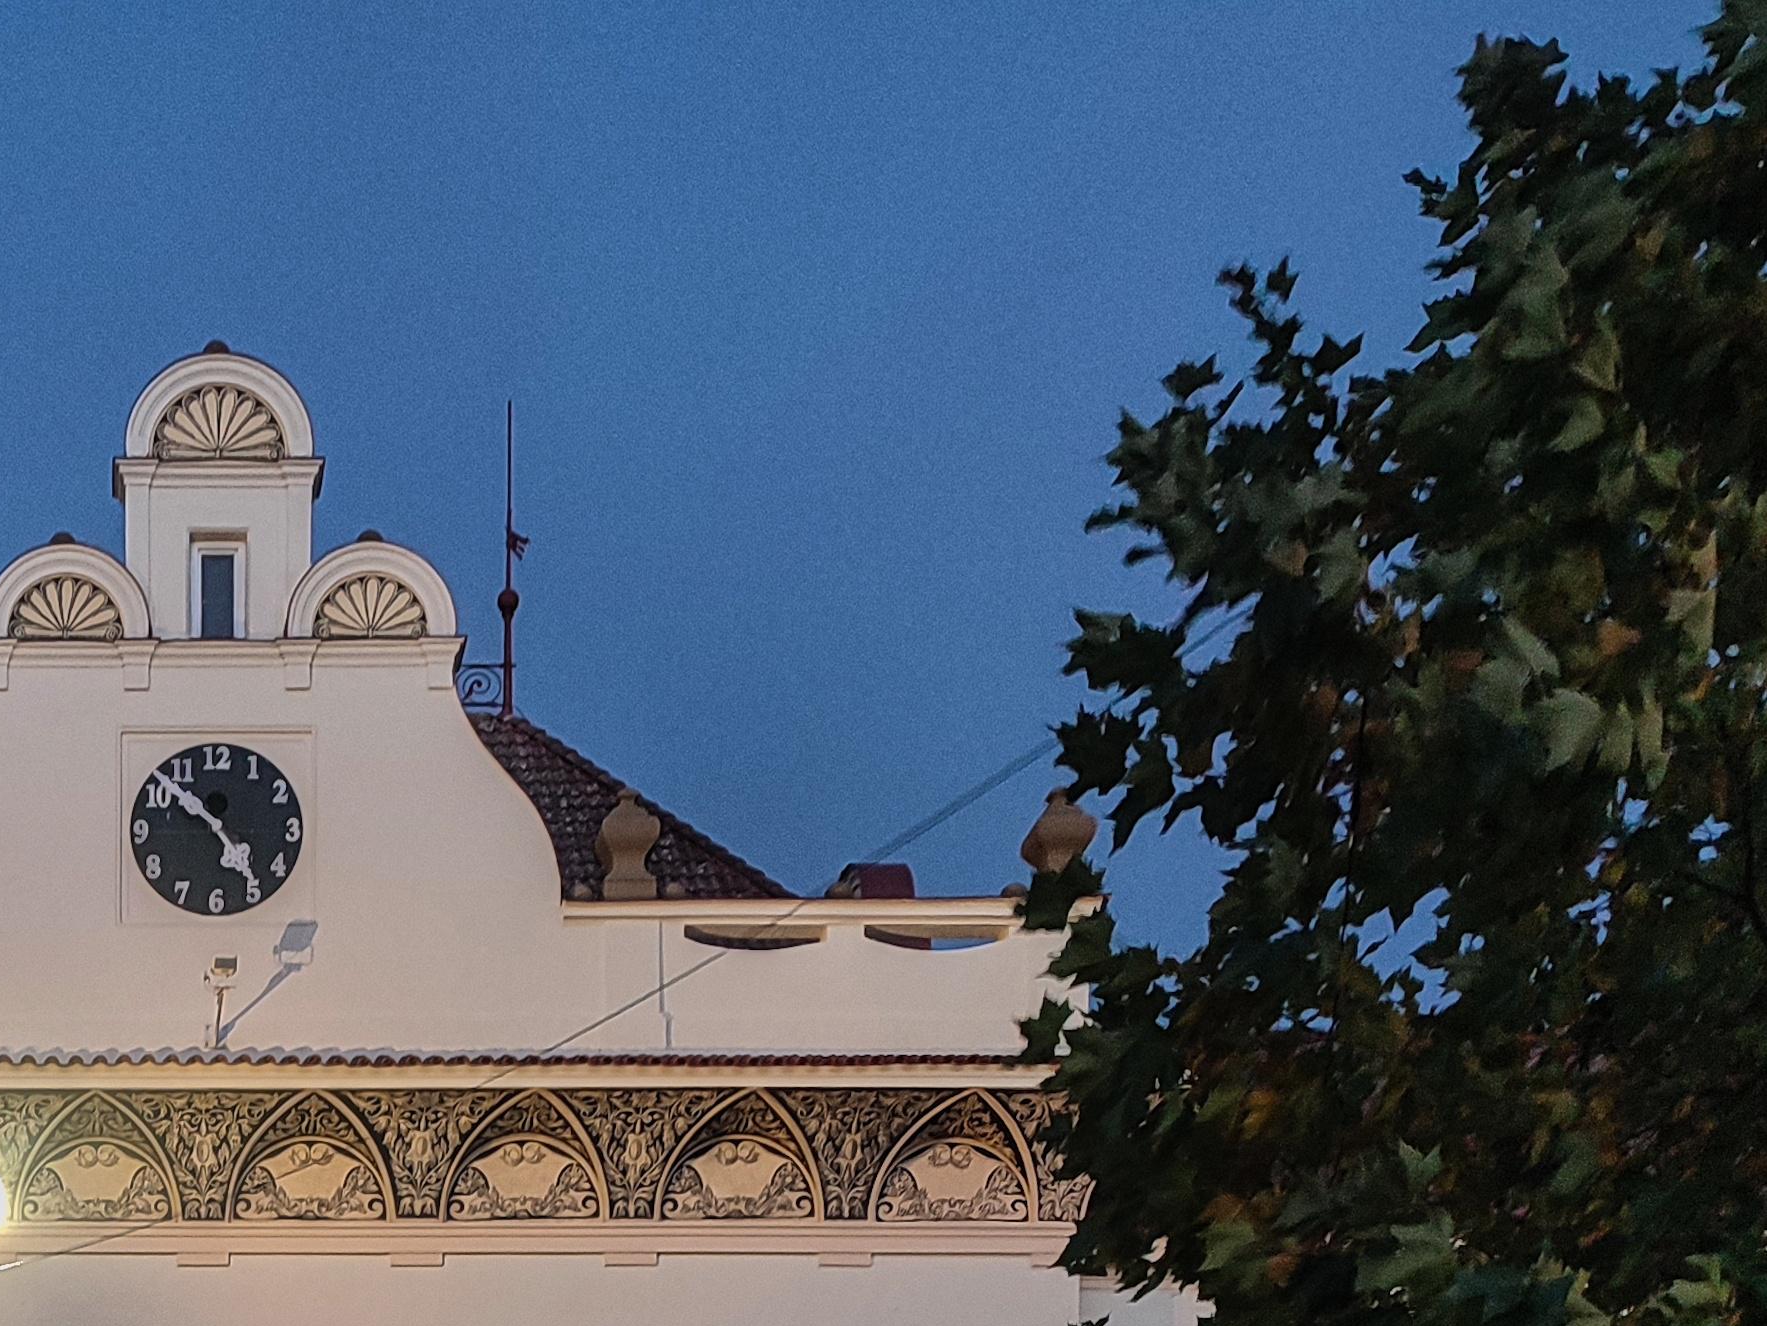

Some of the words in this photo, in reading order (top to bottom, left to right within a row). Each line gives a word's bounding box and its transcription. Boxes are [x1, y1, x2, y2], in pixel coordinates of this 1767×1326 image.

[171, 758, 194, 782] 11
[202, 746, 231, 770] 12
[247, 755, 259, 780] 1
[145, 783, 171, 808] 10
[272, 779, 289, 804] 2
[133, 819, 149, 845] 9
[285, 818, 301, 842] 3
[145, 854, 161, 880] 8
[270, 852, 286, 877] 4
[174, 880, 190, 905] 7
[208, 888, 225, 914] 6
[245, 878, 262, 904] 5
